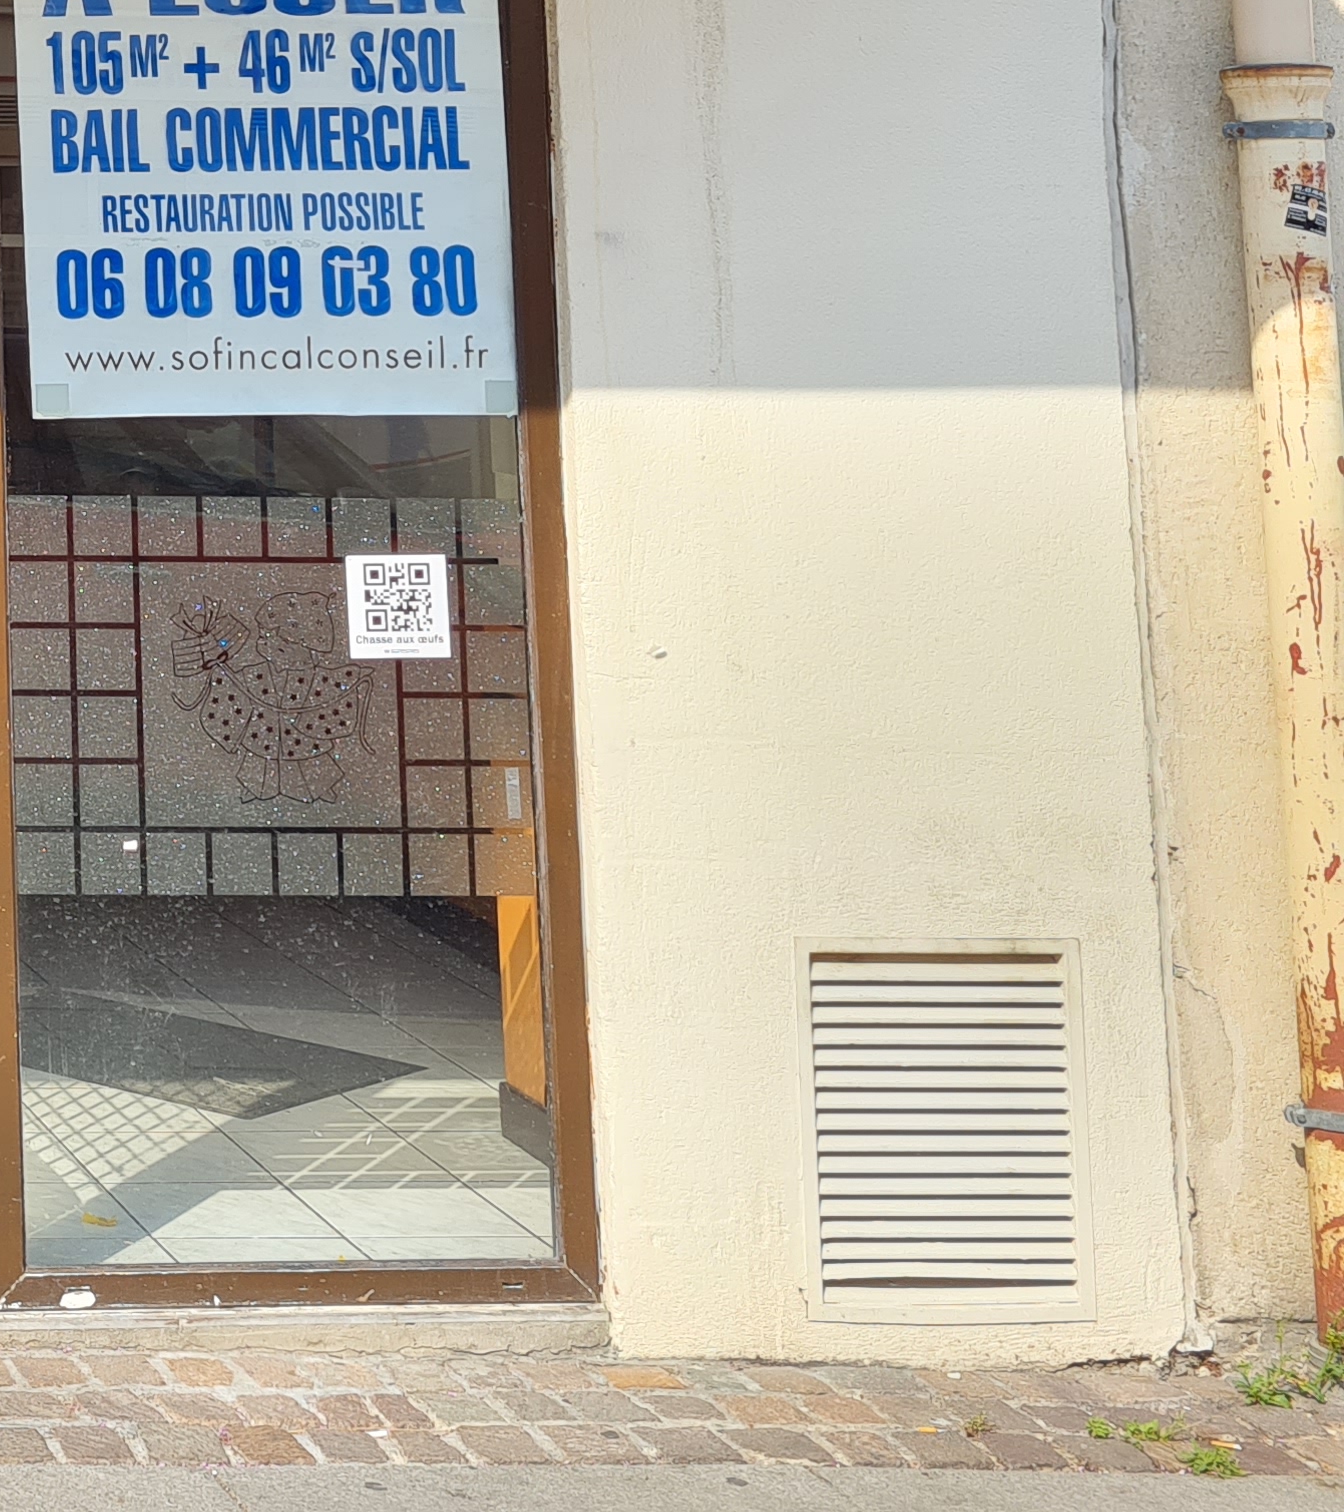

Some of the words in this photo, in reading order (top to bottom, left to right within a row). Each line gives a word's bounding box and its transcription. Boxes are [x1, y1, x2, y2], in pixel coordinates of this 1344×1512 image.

[45, 30, 124, 95] 105
[183, 45, 220, 90] +
[238, 29, 291, 94] 46
[350, 27, 467, 94] S/SOL
[51, 107, 151, 174] BAIL
[165, 105, 471, 173] COMMERCIAL
[102, 193, 294, 234] RESTAURATION
[303, 191, 426, 233] POSSIBLE
[55, 248, 125, 320] 06
[144, 246, 213, 319] 08
[232, 245, 302, 318] 09
[320, 244, 392, 318] 03
[411, 243, 479, 317] 80
[64, 334, 490, 373] www.sofincalconseil.fr
[355, 634, 393, 645] Chasse
[395, 636, 415, 644] aux
[417, 634, 445, 645] œufs
